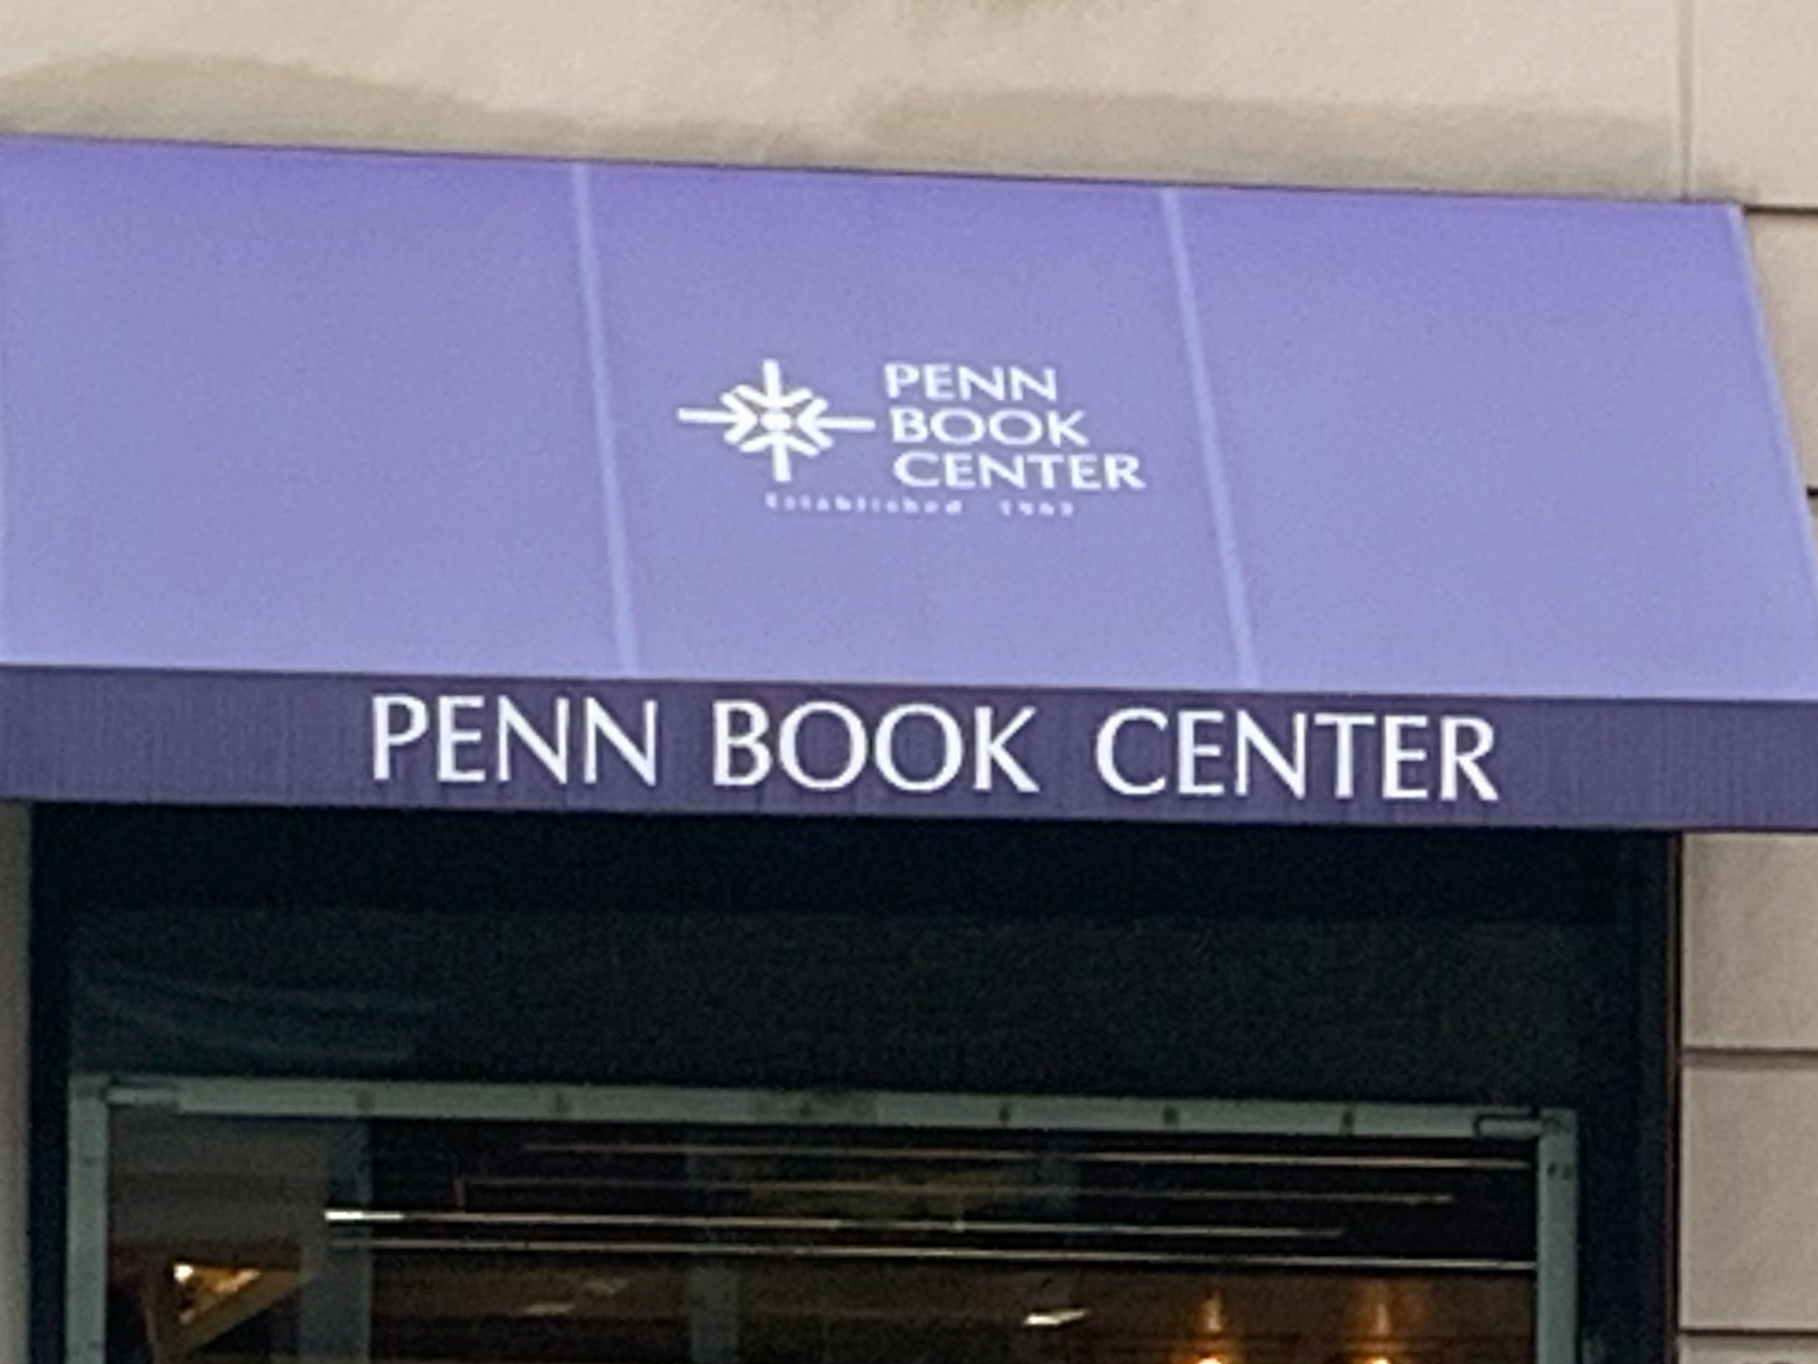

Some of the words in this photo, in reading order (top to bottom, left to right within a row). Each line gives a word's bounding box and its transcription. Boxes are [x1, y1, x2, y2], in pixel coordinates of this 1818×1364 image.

[883, 361, 1058, 402] PENN
[888, 406, 1090, 448] BOOK
[892, 450, 1147, 491] CENTER
[371, 692, 659, 787] PENN
[711, 698, 1041, 793] BOOK
[1093, 706, 1502, 802] CENTER
